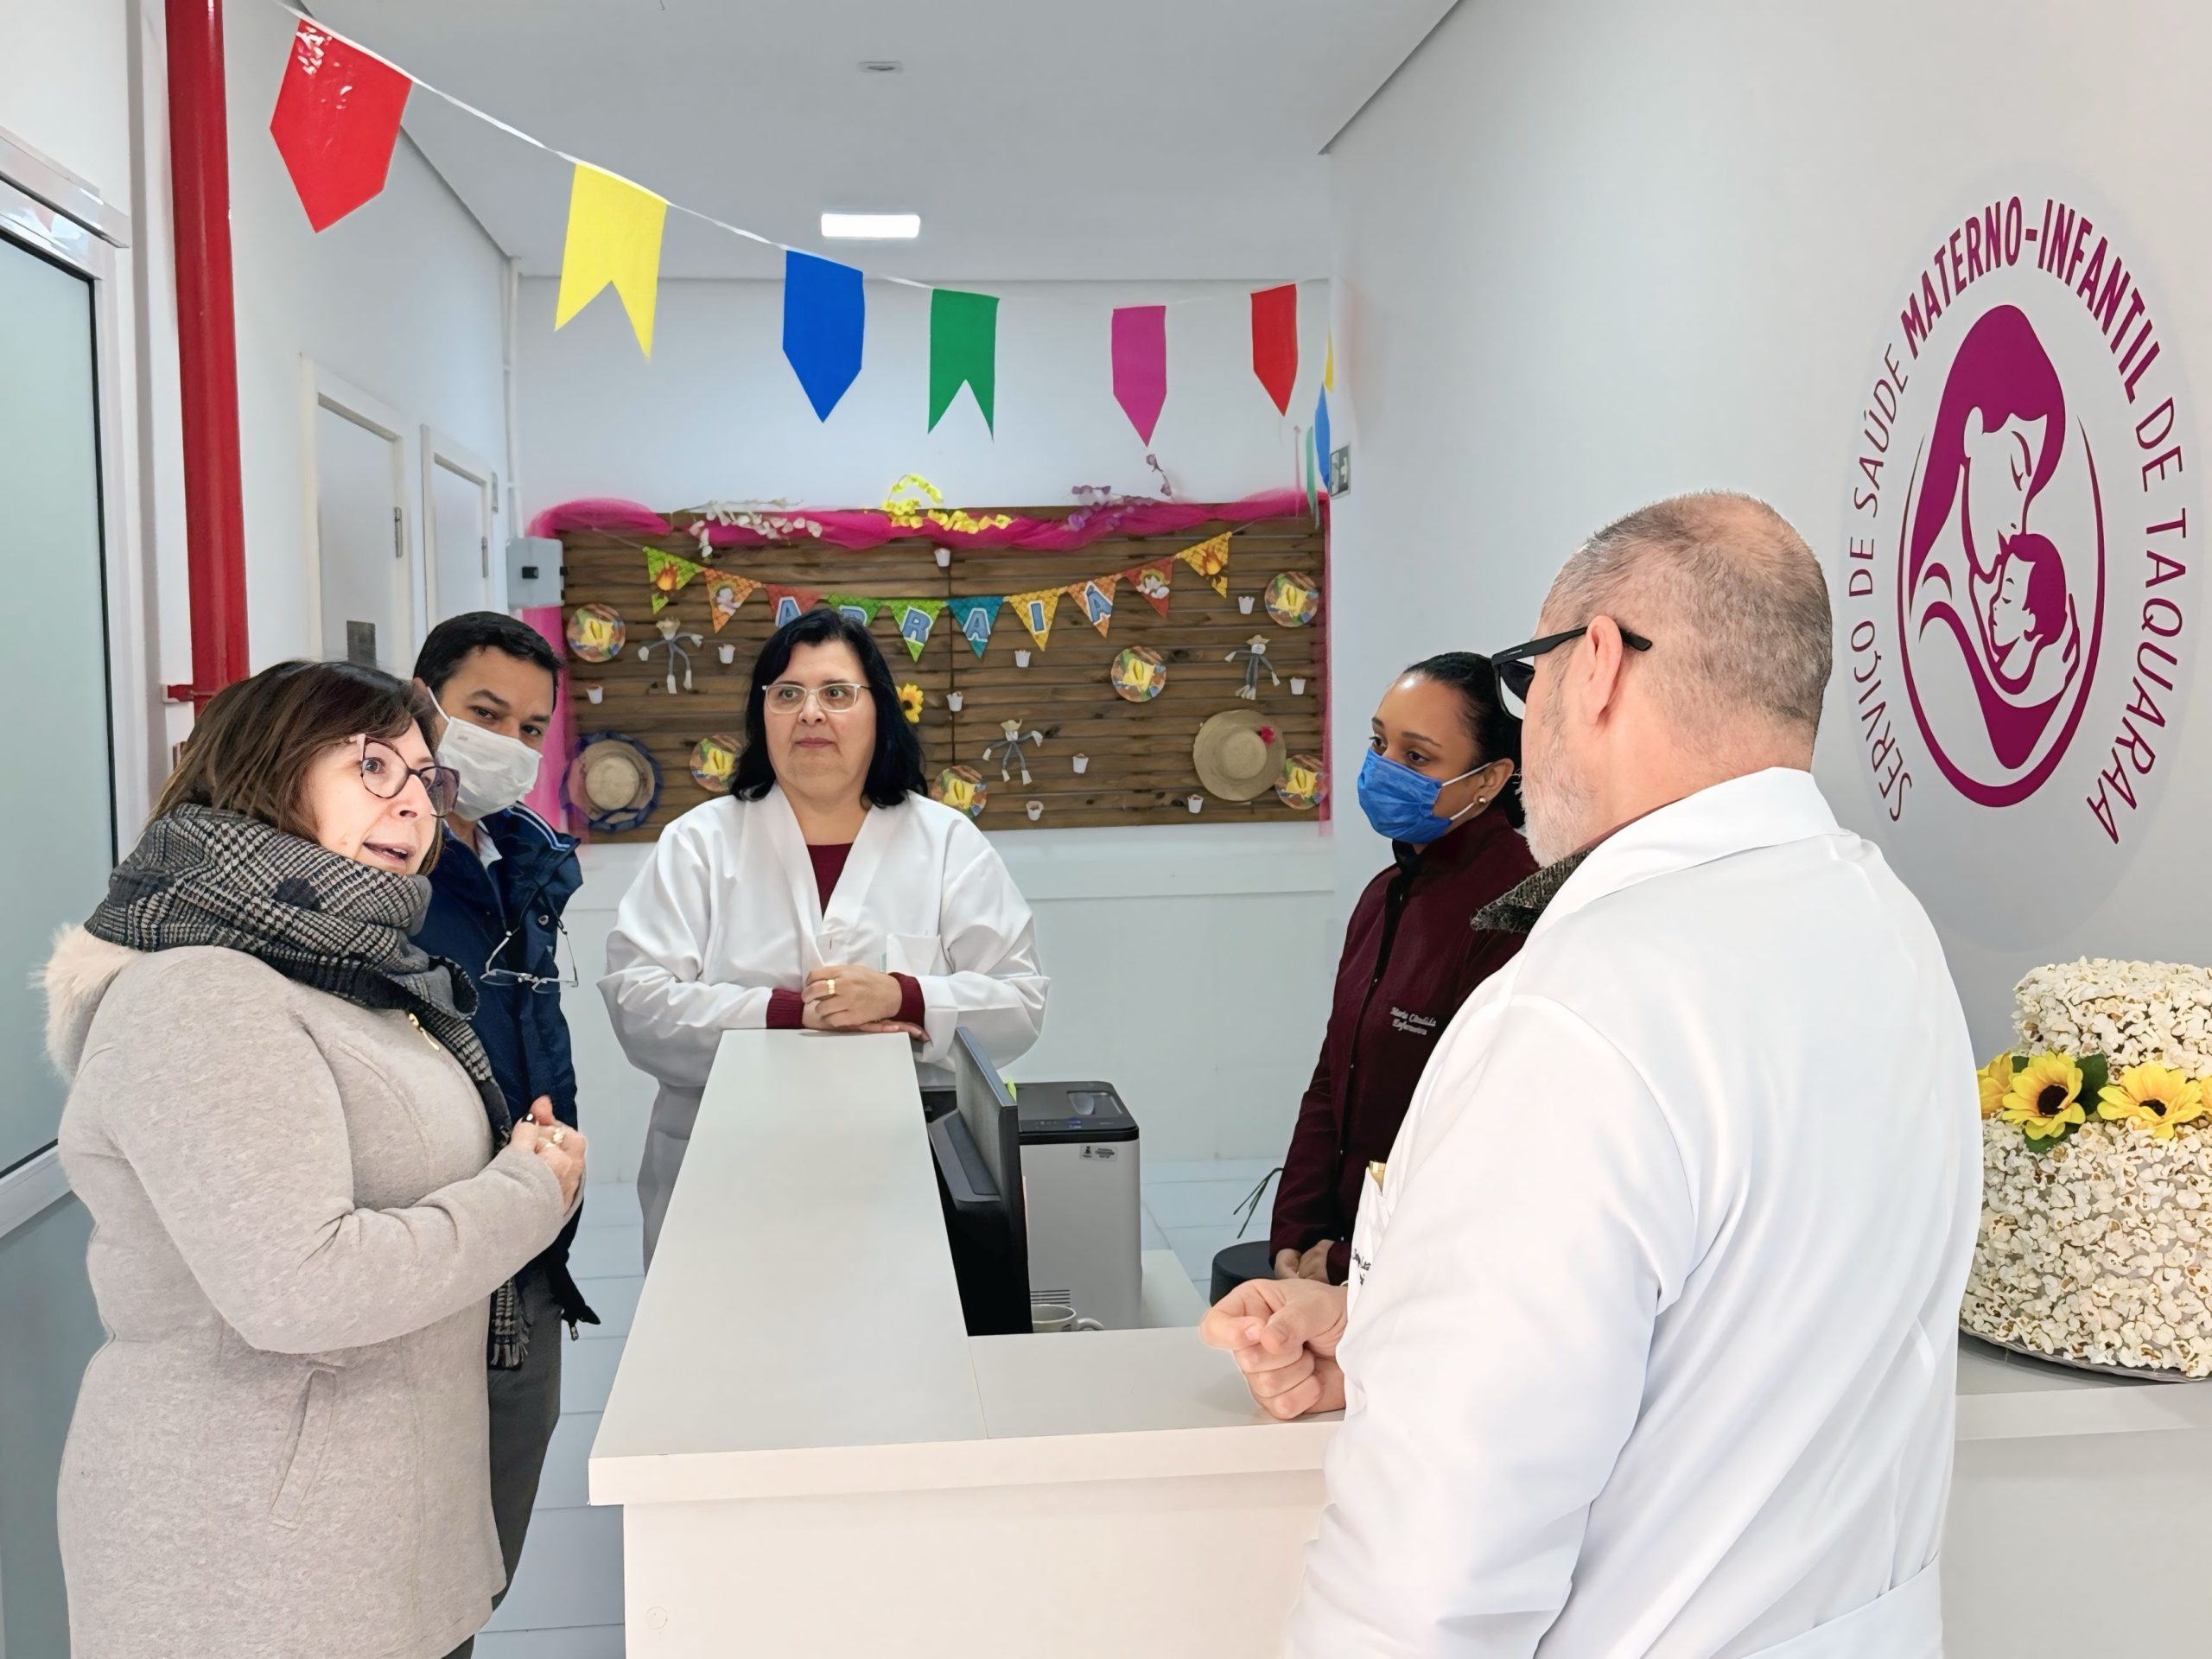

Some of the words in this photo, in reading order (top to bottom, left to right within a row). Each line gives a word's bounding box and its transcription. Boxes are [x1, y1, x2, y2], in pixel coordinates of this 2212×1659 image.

[1900, 195, 2160, 405] MATERNO-INFANTIL
[1853, 342, 1909, 518] SAÚDE
[2135, 397, 2183, 493] DE
[1849, 537, 1875, 598] DE
[1850, 620, 1913, 823] SERVIÇO
